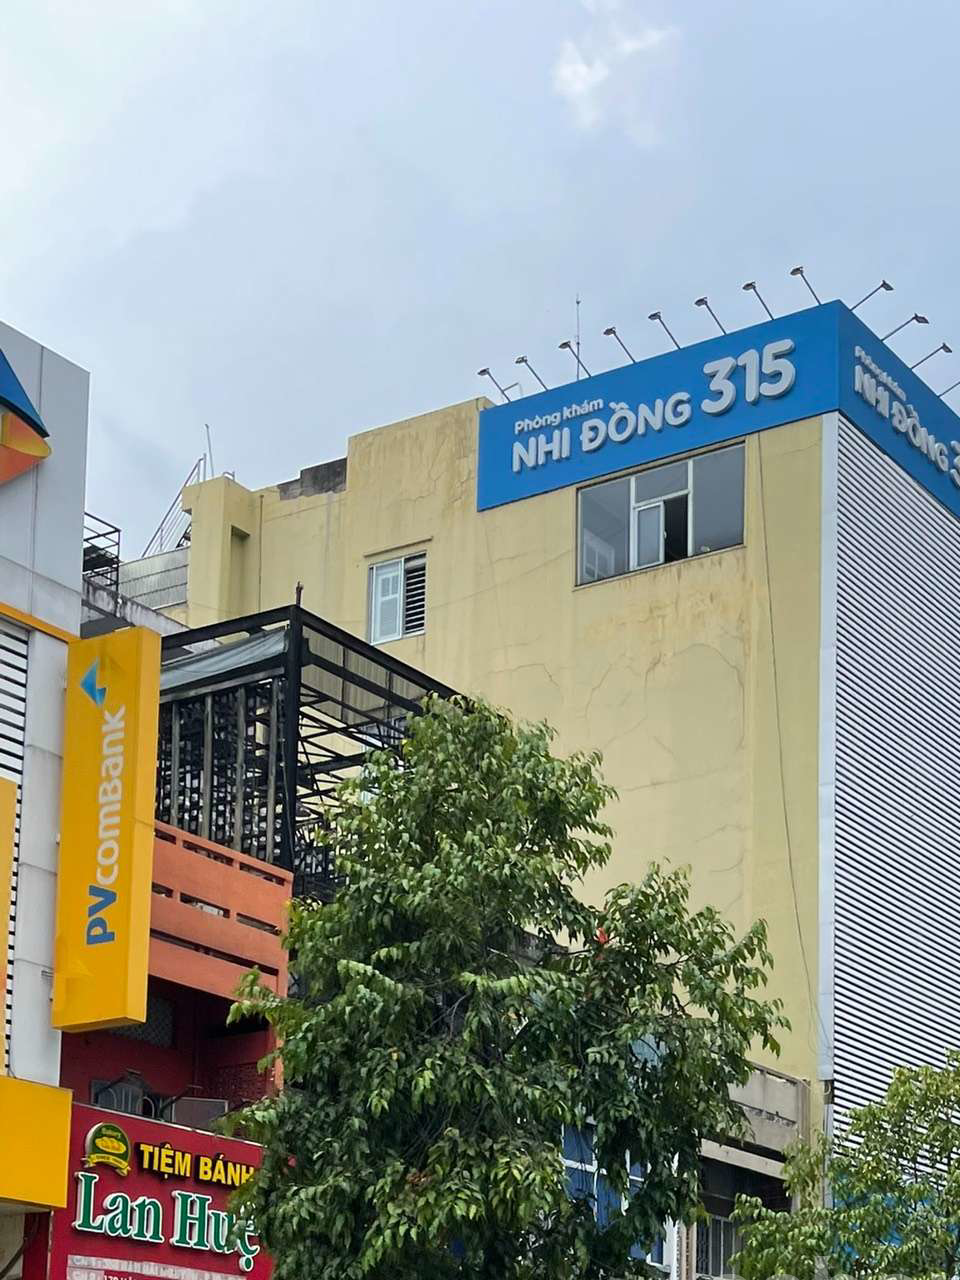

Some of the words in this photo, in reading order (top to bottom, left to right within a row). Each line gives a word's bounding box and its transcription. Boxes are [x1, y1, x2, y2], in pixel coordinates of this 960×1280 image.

[512, 427, 571, 473] NHI
[580, 391, 692, 452] ĐỒNG
[700, 338, 797, 416] 315
[514, 412, 561, 435] Phòng
[562, 398, 604, 421] khám
[86, 704, 126, 946] PVcomBank
[140, 1144, 191, 1179] TIỆM
[199, 1154, 256, 1187] BÁNH
[74, 1171, 165, 1244] Lan
